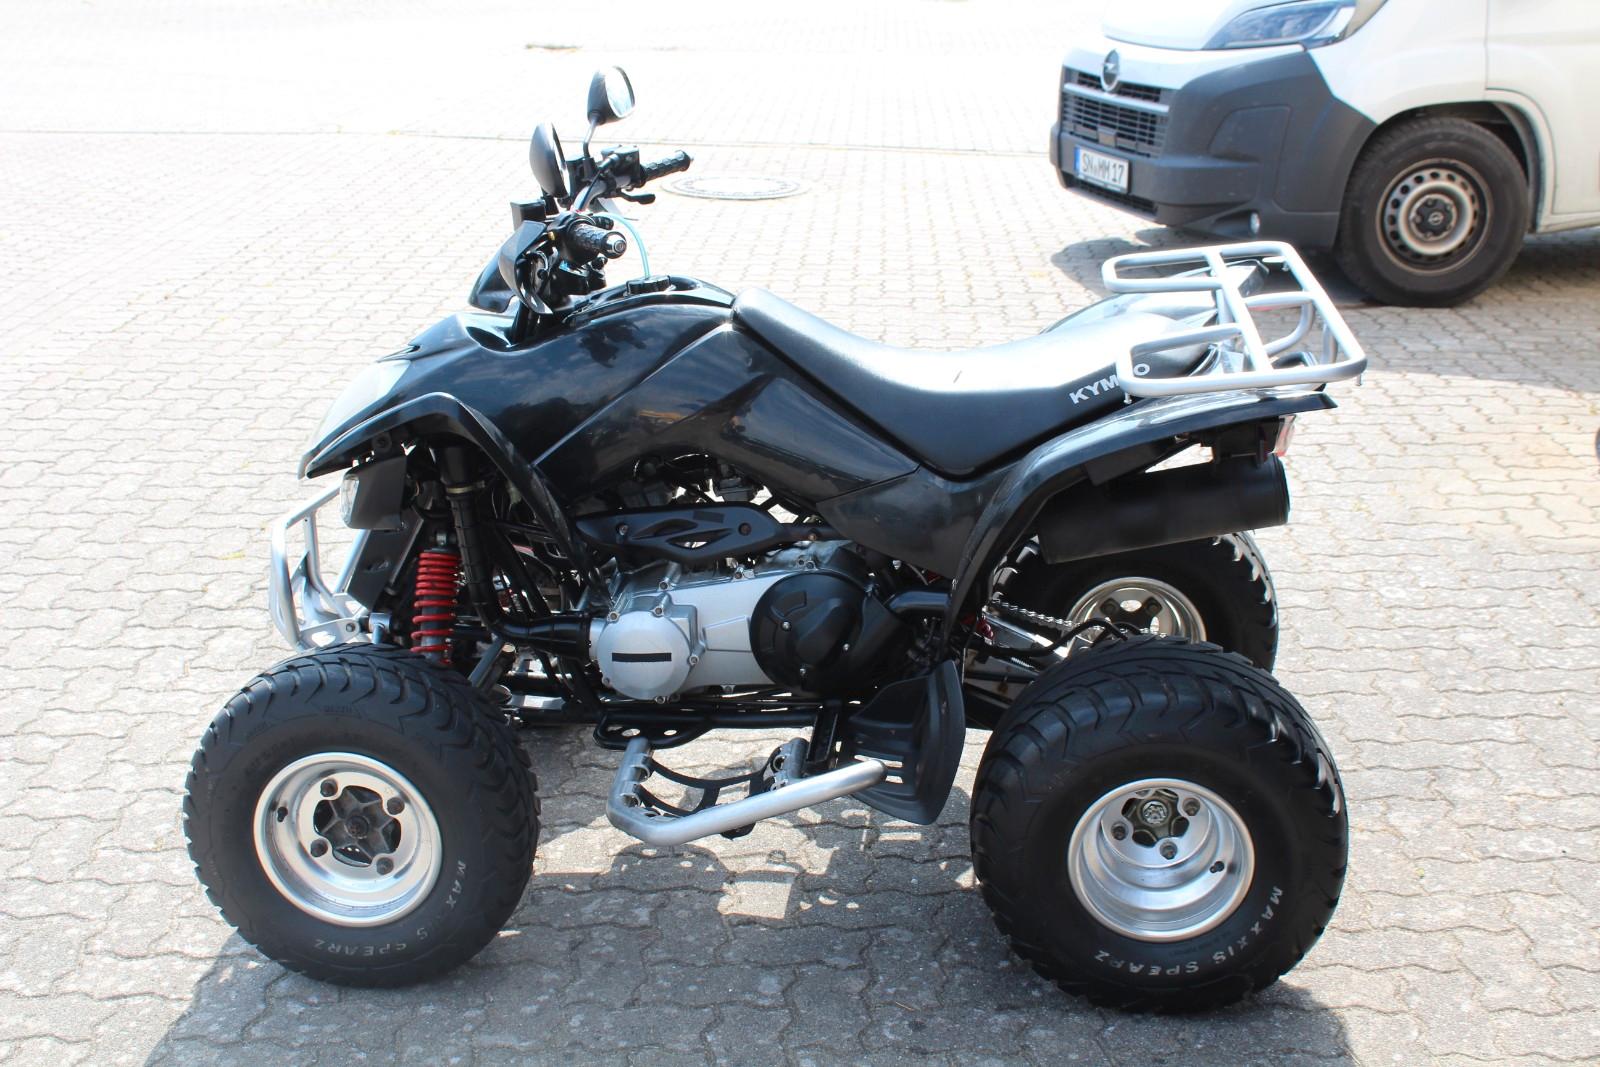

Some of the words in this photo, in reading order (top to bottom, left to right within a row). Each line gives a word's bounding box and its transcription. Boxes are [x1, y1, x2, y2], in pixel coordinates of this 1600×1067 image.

[1112, 163, 1125, 184] 17
[1069, 363, 1150, 404] KYMO
[1212, 886, 1284, 965] MAXXIS
